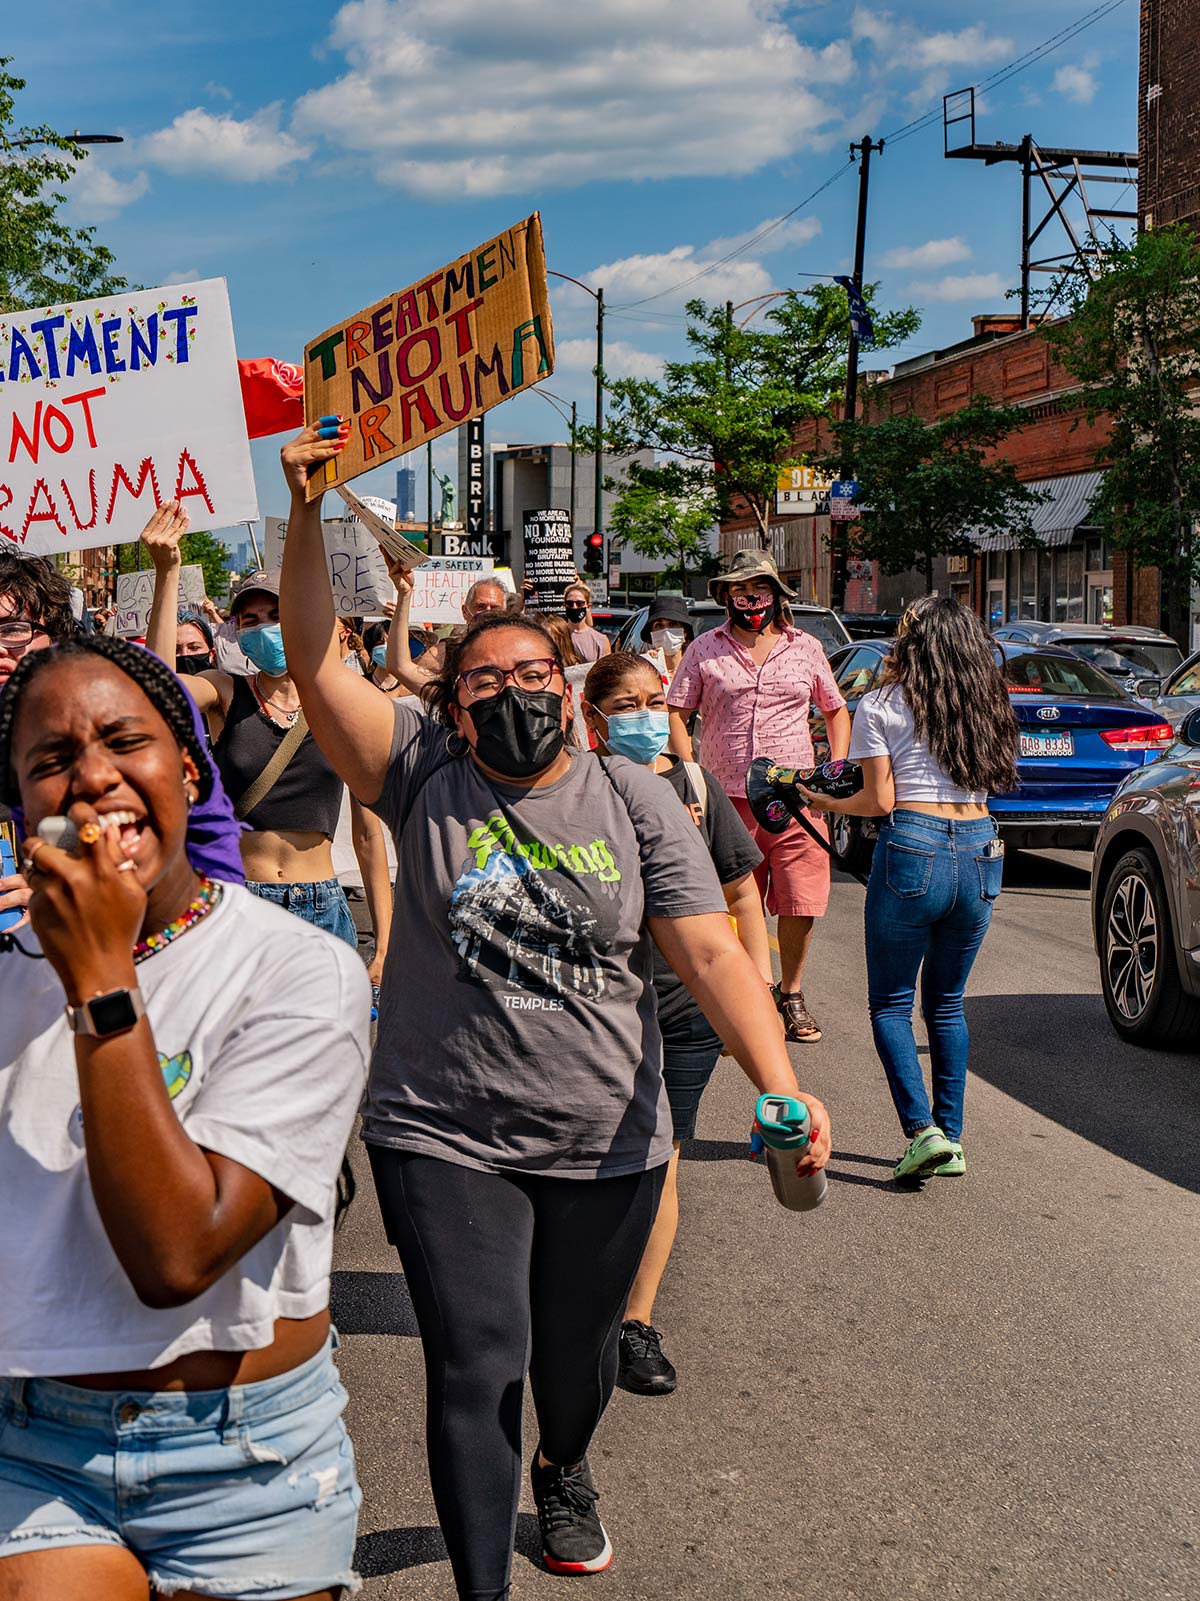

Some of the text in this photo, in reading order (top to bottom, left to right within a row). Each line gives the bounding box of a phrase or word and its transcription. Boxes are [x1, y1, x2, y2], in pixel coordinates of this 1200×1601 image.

[350, 297, 484, 413] NOT
[7, 386, 107, 464] NOT
[470, 417, 482, 531] IBERTY
[524, 524, 539, 538] NO
[330, 552, 374, 594] RE
[445, 560, 482, 570] SAFETY
[425, 572, 476, 588] HEALTH
[411, 589, 436, 609] ISIS
[117, 611, 140, 629] NOT
[1045, 737, 1070, 751] 8335
[504, 995, 565, 1012] TEMPLES
